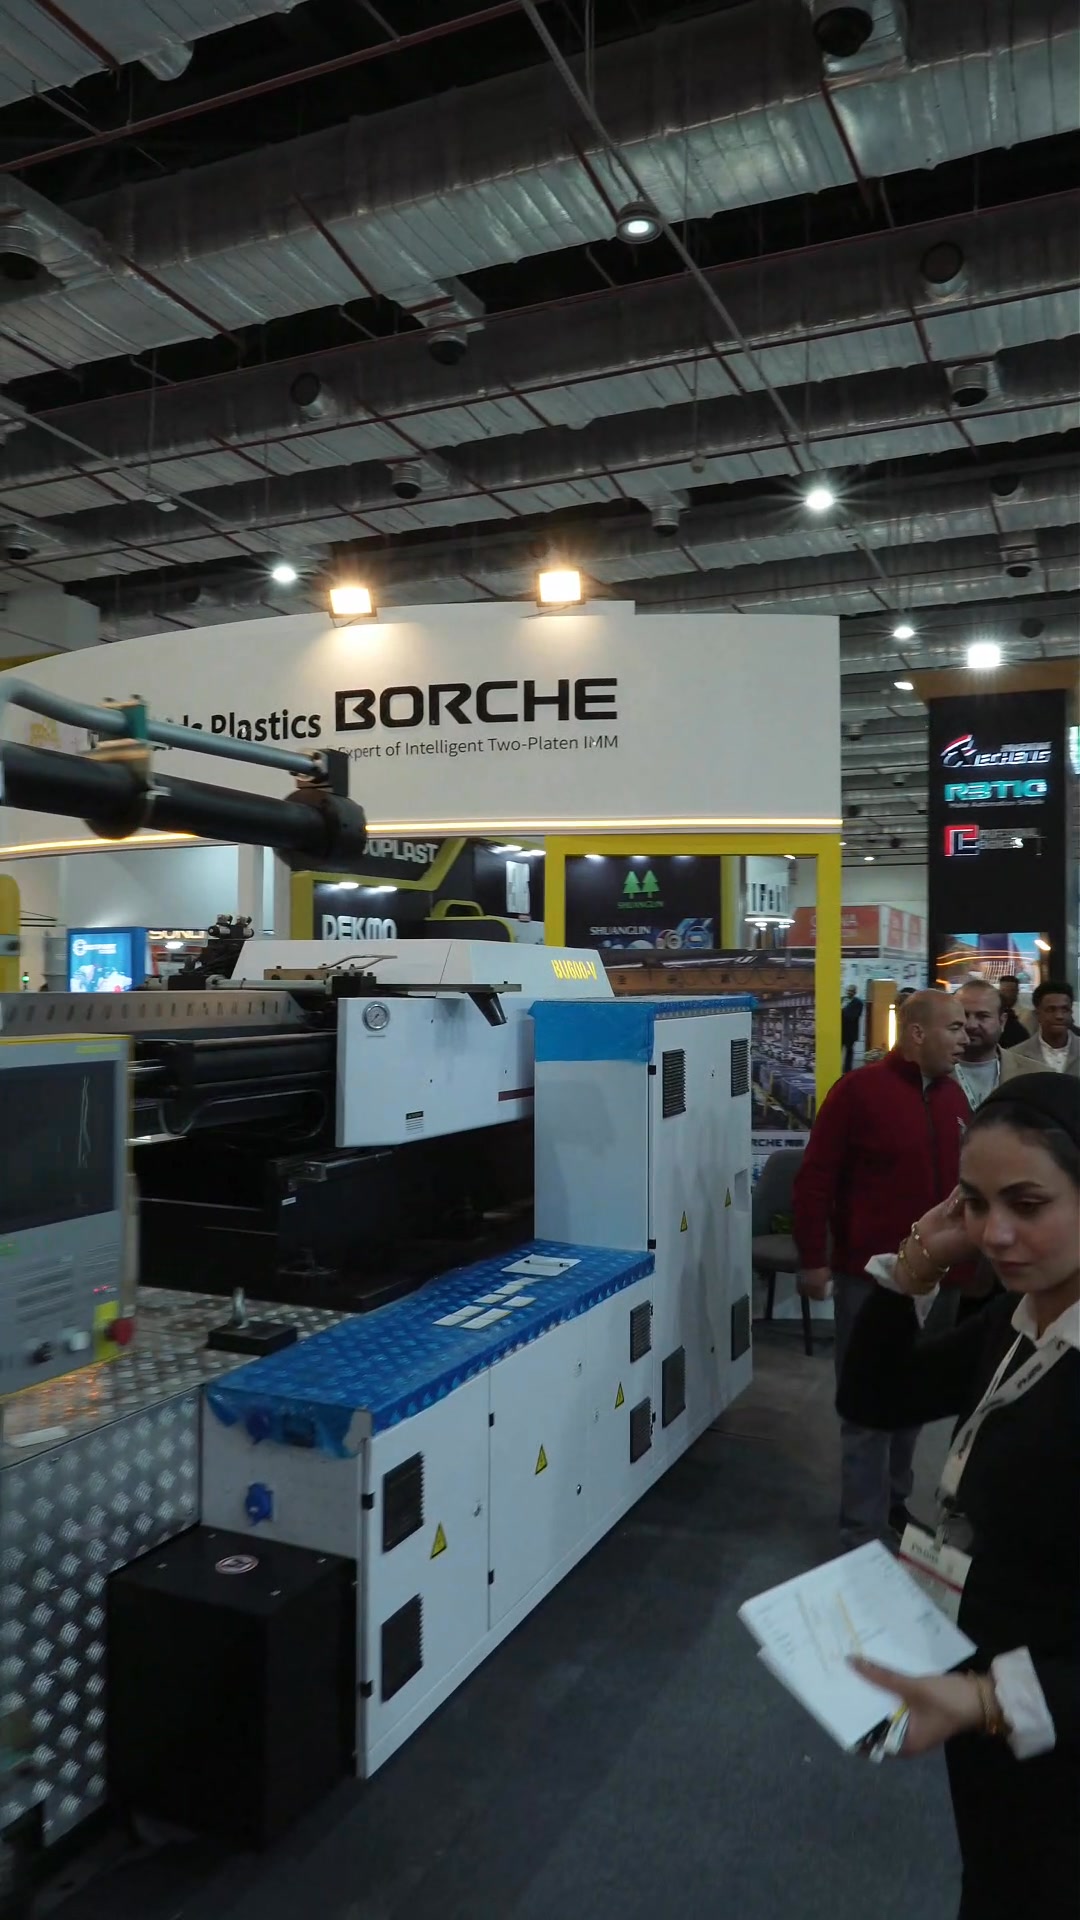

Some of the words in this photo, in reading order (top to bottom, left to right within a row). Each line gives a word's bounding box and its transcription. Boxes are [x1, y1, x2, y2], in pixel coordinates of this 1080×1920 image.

[335, 678, 618, 731] BORCHE
[211, 709, 322, 741] Plastics
[385, 742, 401, 757] of
[405, 739, 484, 757] Intelligent
[487, 736, 578, 751] Two-Platen
[584, 735, 618, 749] IMM
